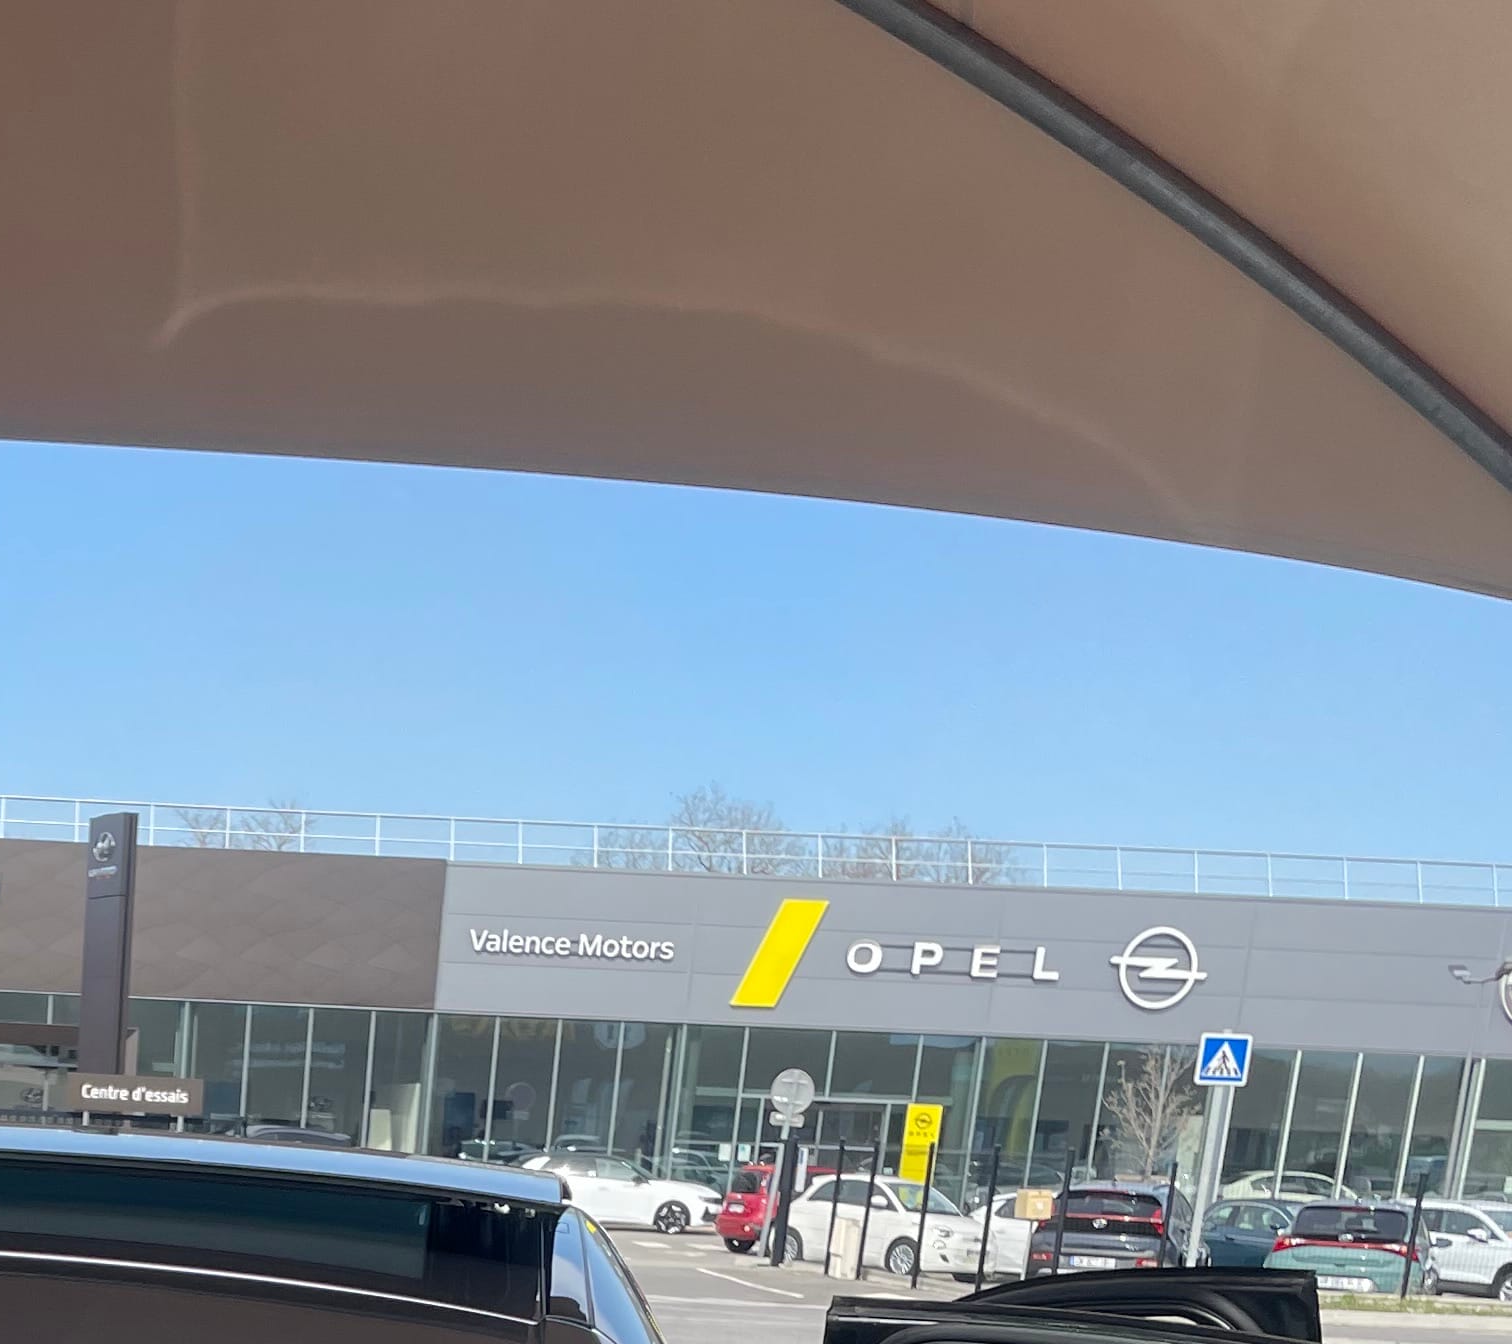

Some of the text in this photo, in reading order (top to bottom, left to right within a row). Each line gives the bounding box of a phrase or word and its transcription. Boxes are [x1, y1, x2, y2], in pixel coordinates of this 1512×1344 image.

[469, 929, 675, 960] Valence Motors
[846, 939, 1060, 981] OPEL
[81, 1084, 189, 1104] Centre d'essais
